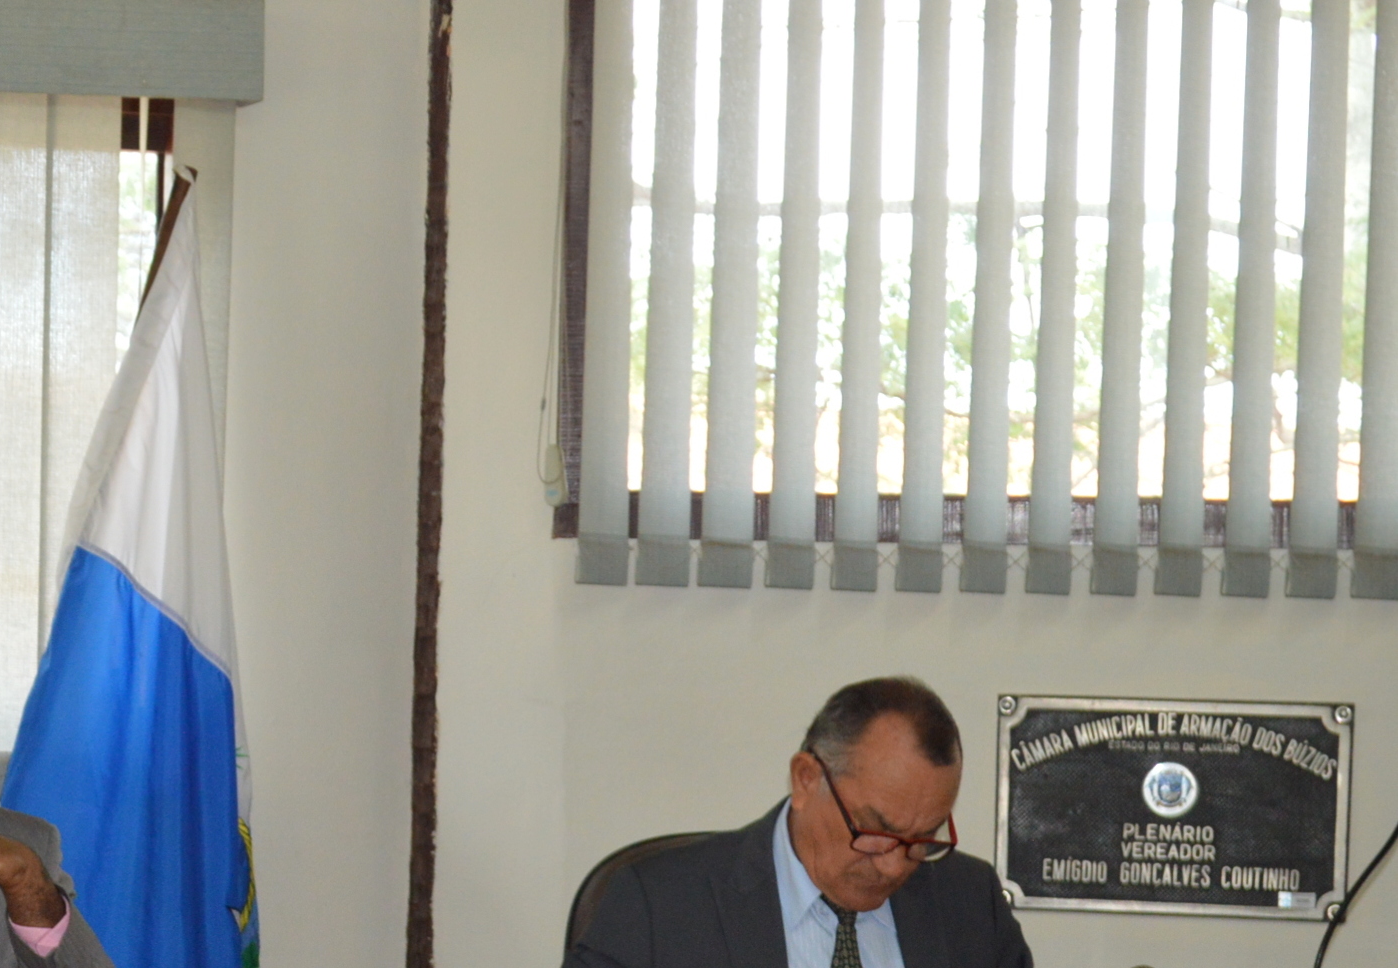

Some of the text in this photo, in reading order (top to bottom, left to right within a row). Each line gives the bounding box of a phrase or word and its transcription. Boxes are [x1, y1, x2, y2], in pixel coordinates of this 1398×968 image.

[1010, 711, 1338, 781] CÂMARA MUNICIPAL DE ARMAÇÃO DOS BÚZIOS
[1108, 739, 1241, 754] ESTADO DO RIO DE JANEIRO
[1122, 822, 1214, 844] PLENÁRIO
[1120, 840, 1216, 862] VEREADOR
[1042, 856, 1108, 883] EMÍGDIO
[1220, 865, 1301, 892] COUTINHO
